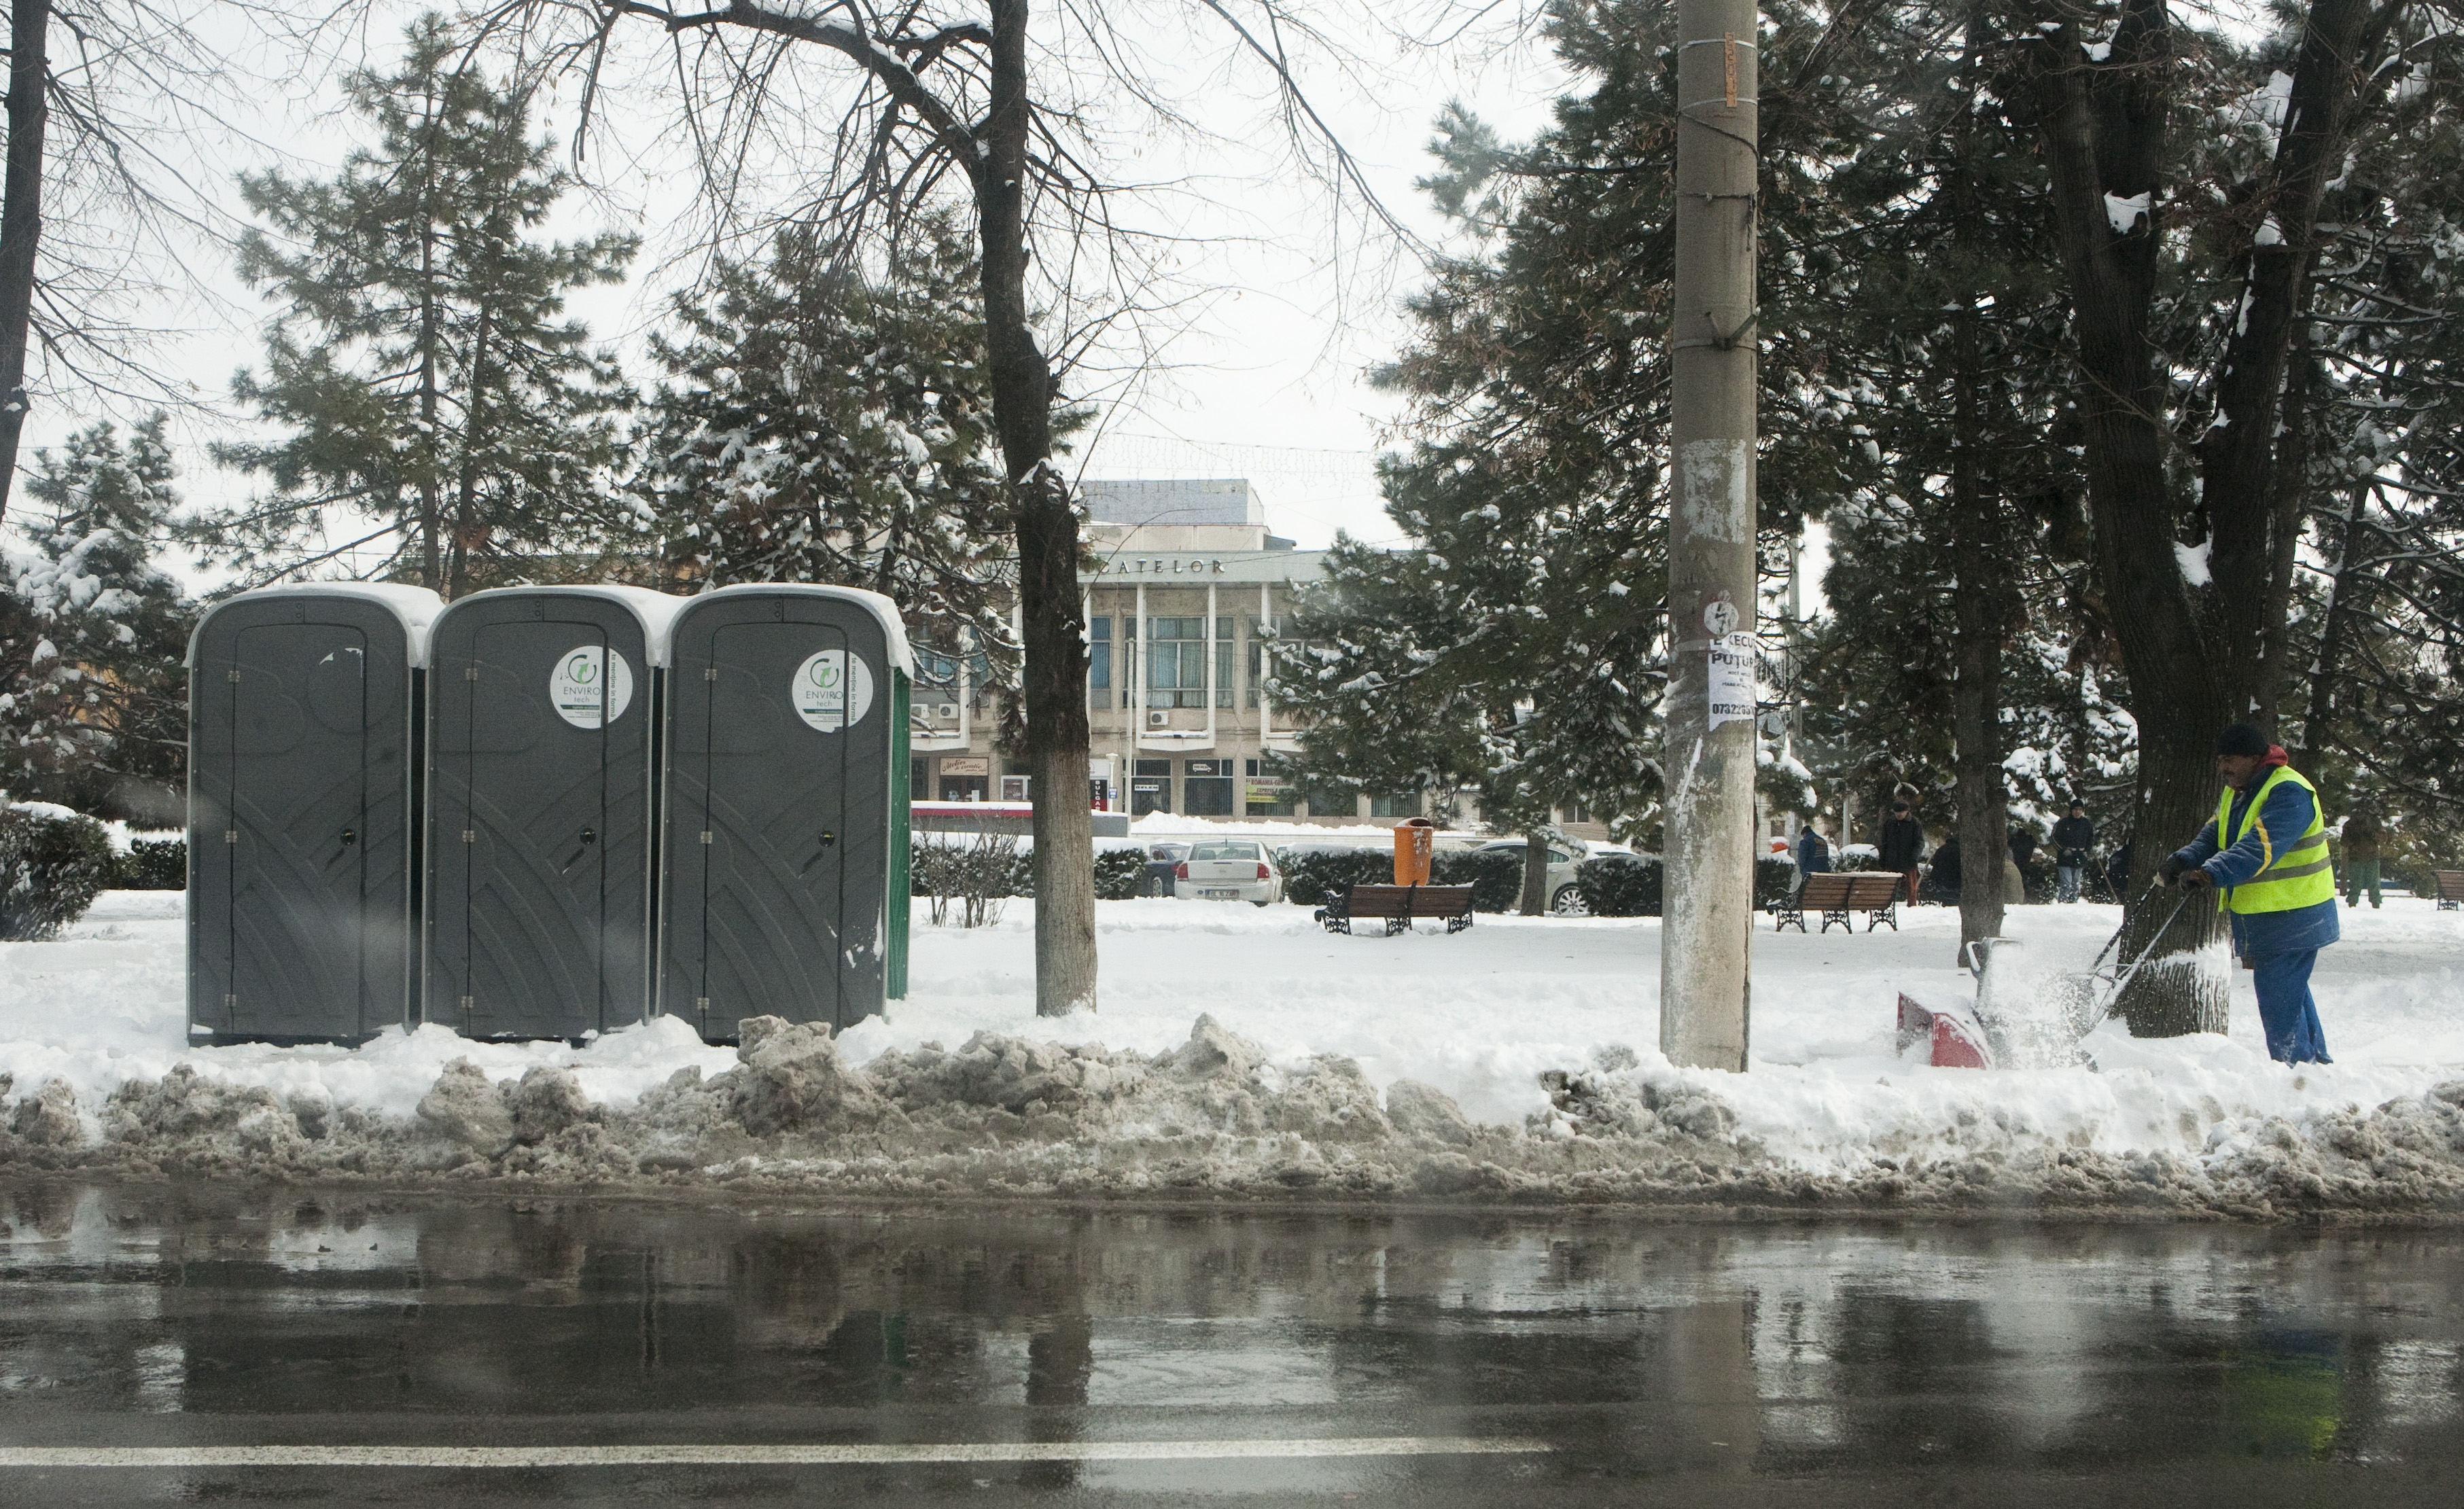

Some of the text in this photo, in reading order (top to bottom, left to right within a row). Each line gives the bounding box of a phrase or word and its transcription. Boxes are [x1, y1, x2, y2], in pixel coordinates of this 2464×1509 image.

[1714, 635, 1756, 649] EXECU
[563, 686, 601, 695] ENVIRO
[806, 690, 843, 699] ENVIRO
